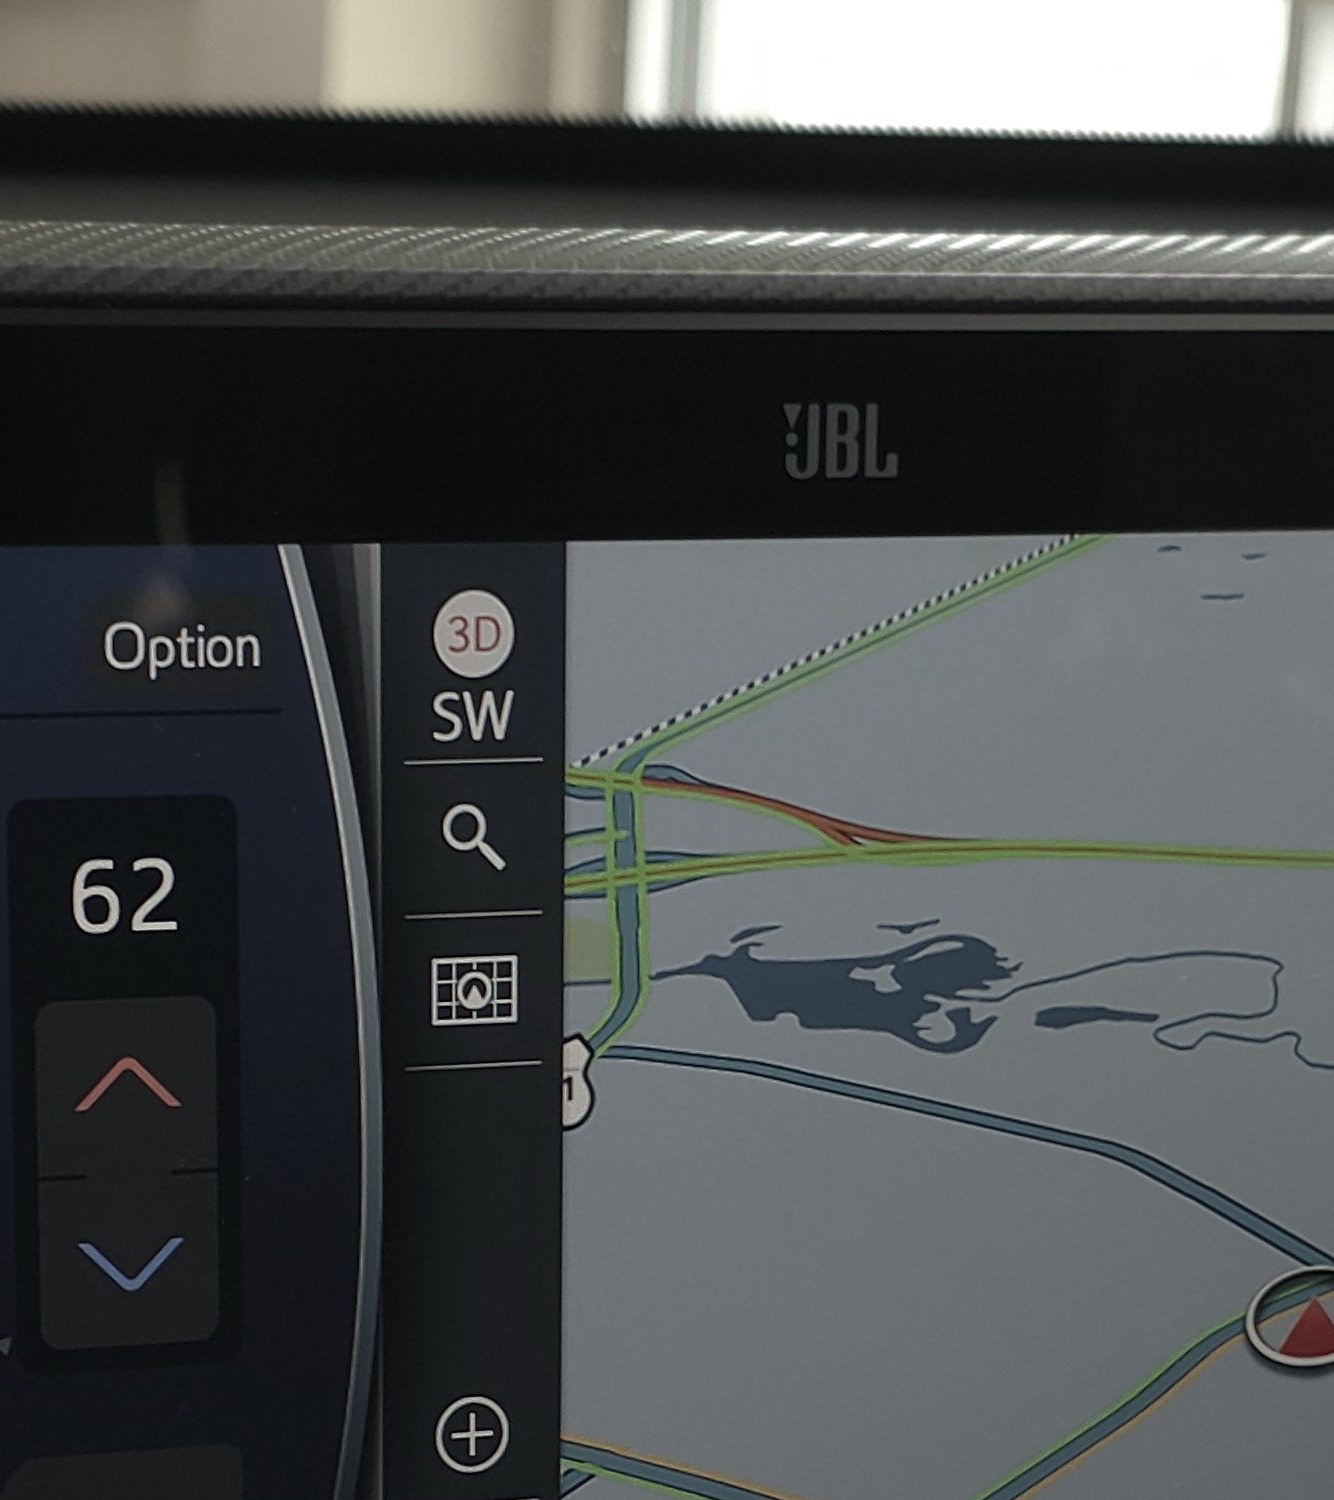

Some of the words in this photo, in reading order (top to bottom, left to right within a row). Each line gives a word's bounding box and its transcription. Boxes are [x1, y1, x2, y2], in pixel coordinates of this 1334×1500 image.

[782, 402, 899, 480] JBL
[103, 620, 262, 681] Option
[447, 615, 501, 653] 3D
[432, 689, 515, 743] SW
[71, 856, 179, 935] 62
